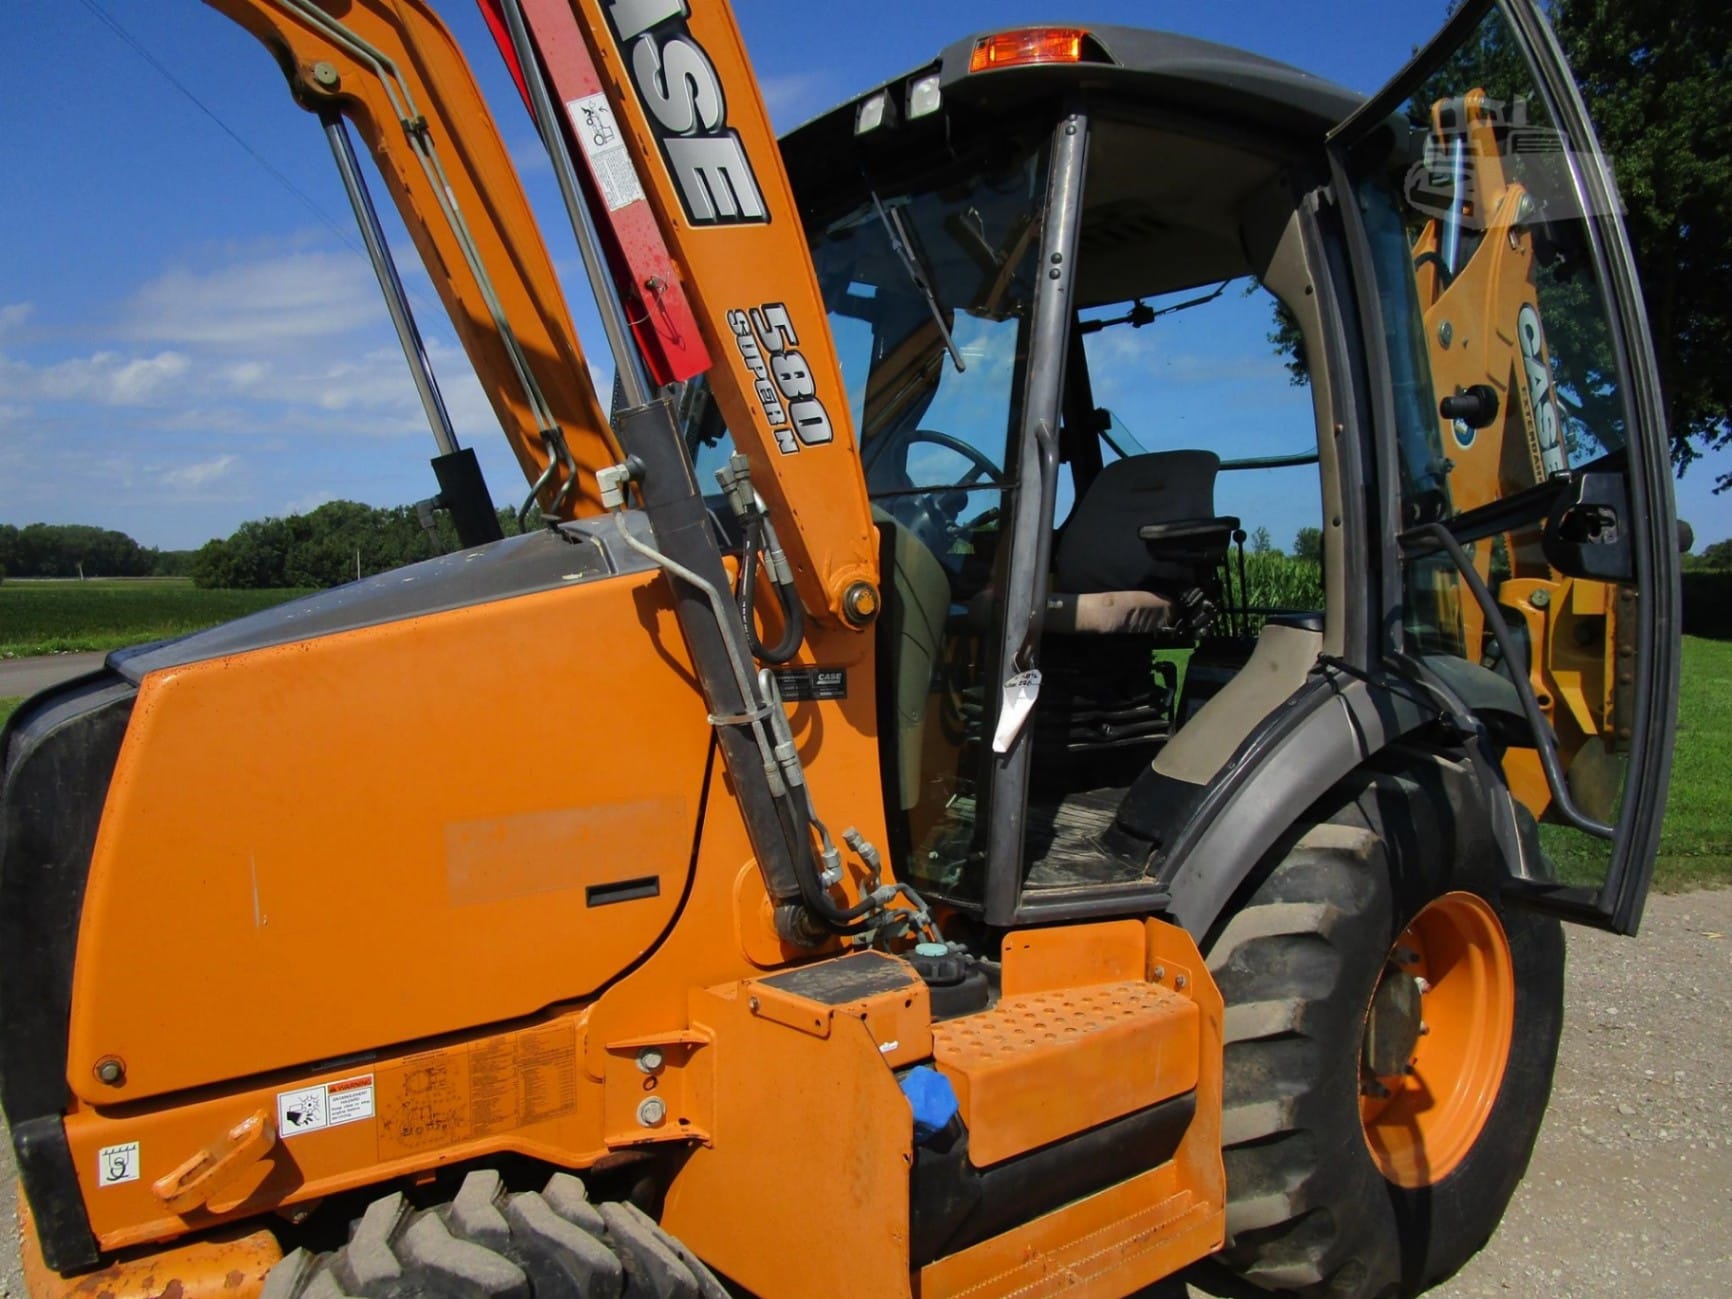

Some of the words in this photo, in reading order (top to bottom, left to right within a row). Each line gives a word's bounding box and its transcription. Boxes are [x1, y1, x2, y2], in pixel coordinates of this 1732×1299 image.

[606, 0, 770, 223] SE
[727, 309, 787, 425] SUPER
[773, 429, 800, 454] N
[749, 302, 833, 445] 580
[817, 672, 842, 681] CASE
